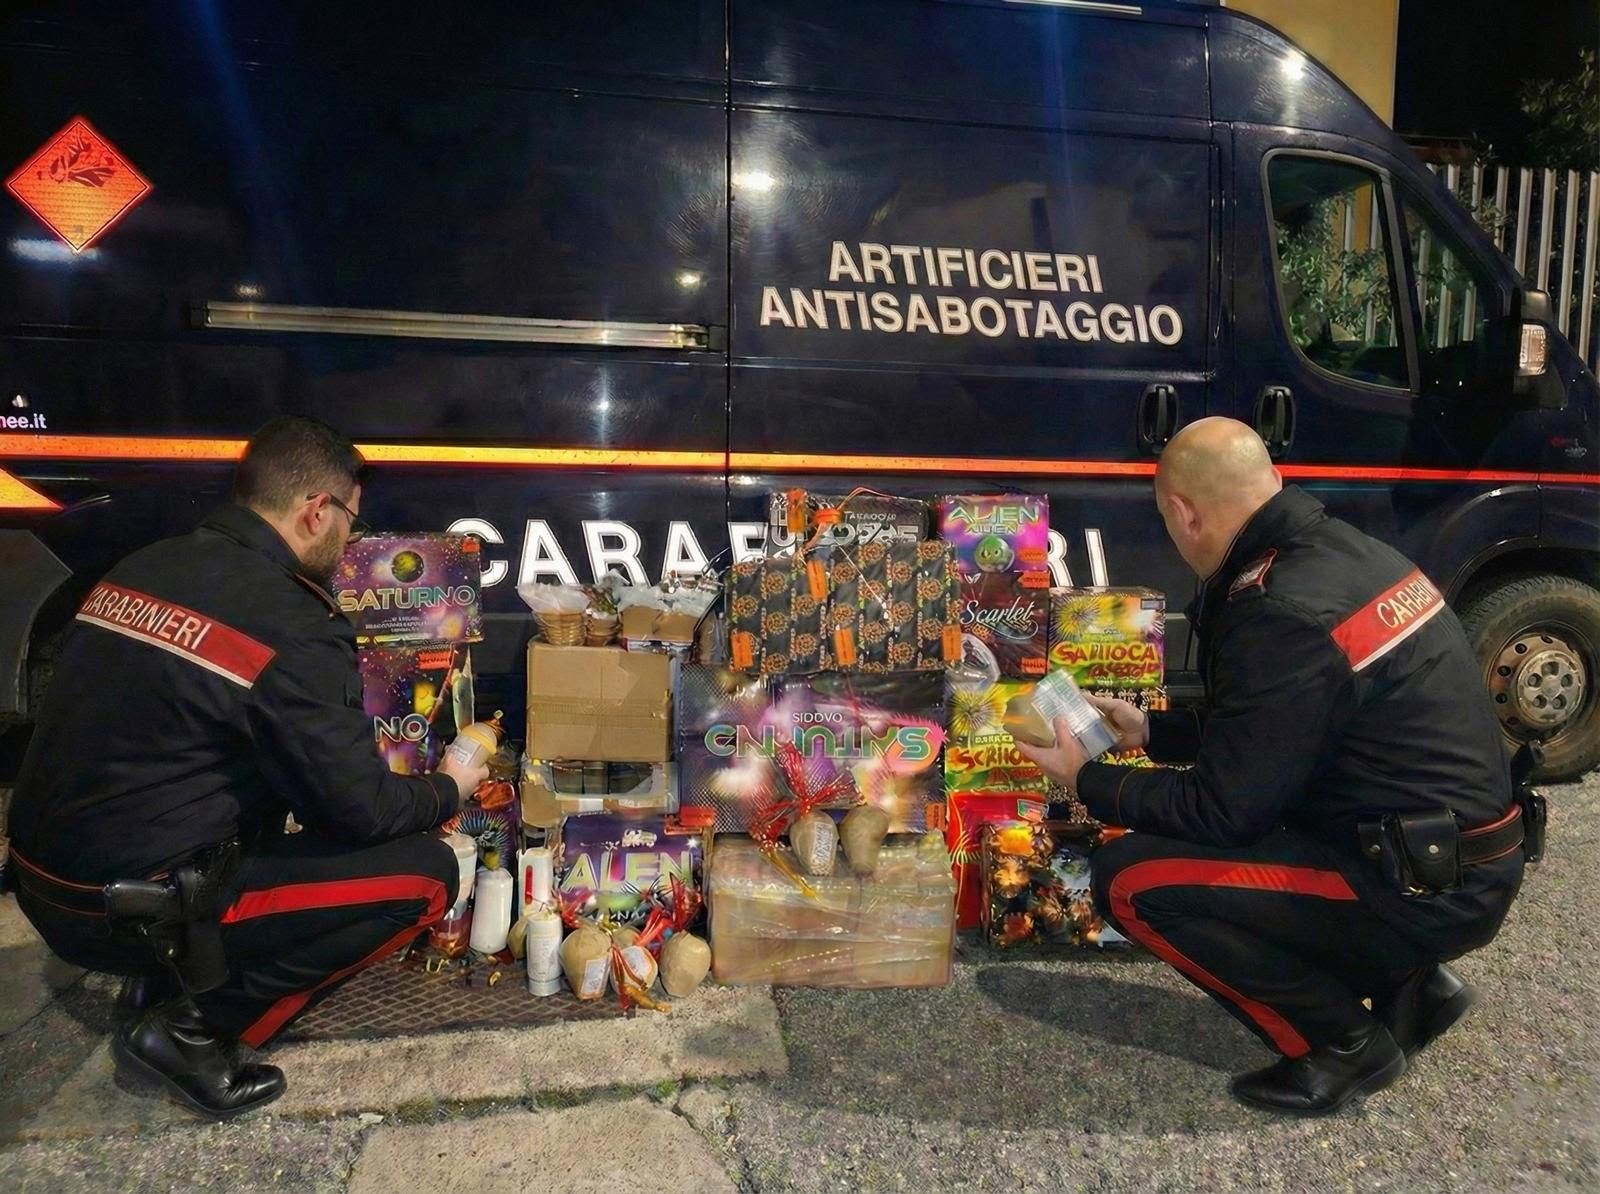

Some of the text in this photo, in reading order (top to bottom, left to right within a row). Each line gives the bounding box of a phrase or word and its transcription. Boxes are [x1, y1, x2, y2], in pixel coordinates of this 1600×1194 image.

[828, 240, 1104, 294] ARTIFICIERI
[760, 286, 1184, 346] ANTISABOTAGGIO
[337, 585, 476, 612] SATURNO
[960, 596, 1036, 626] Scarlet
